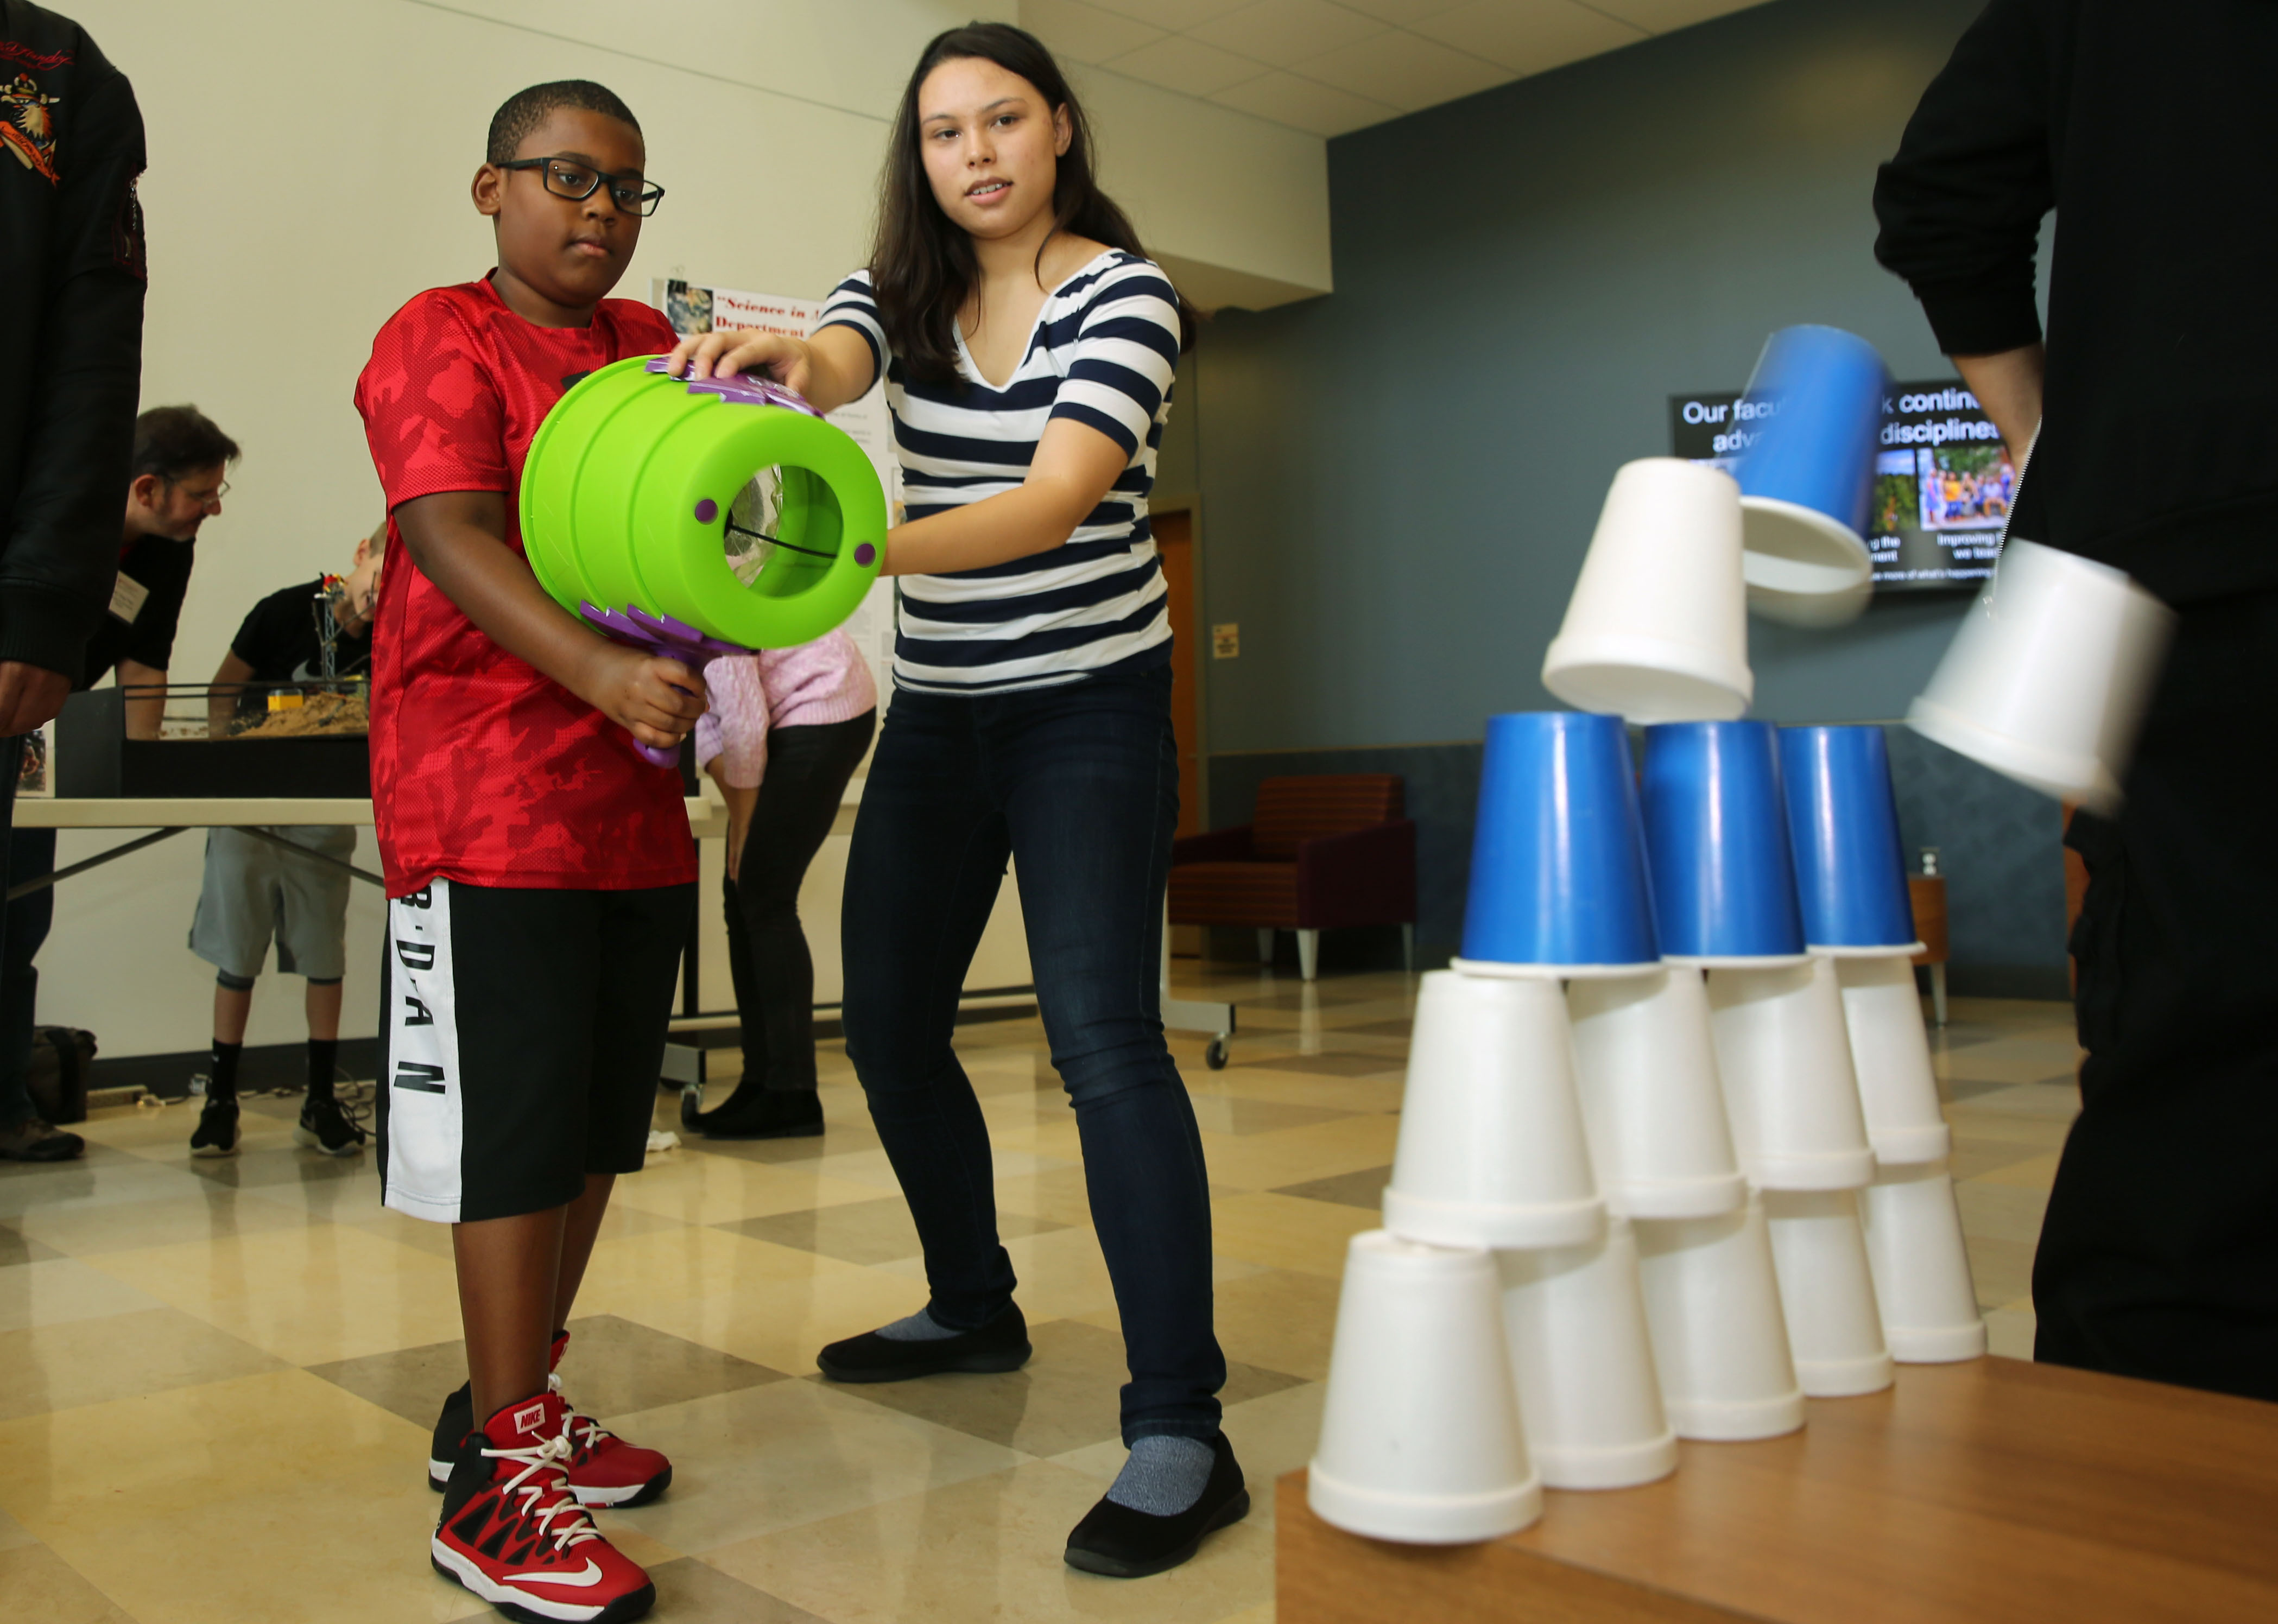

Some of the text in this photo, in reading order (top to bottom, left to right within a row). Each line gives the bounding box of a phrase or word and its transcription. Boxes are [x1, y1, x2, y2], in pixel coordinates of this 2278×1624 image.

[791, 306, 805, 319] in
[1683, 401, 1729, 425] Our
[1880, 535, 1901, 549] the
[1937, 534, 1996, 548] Improving
[1953, 547, 1973, 560] we
[520, 1409, 541, 1429] NIKE
